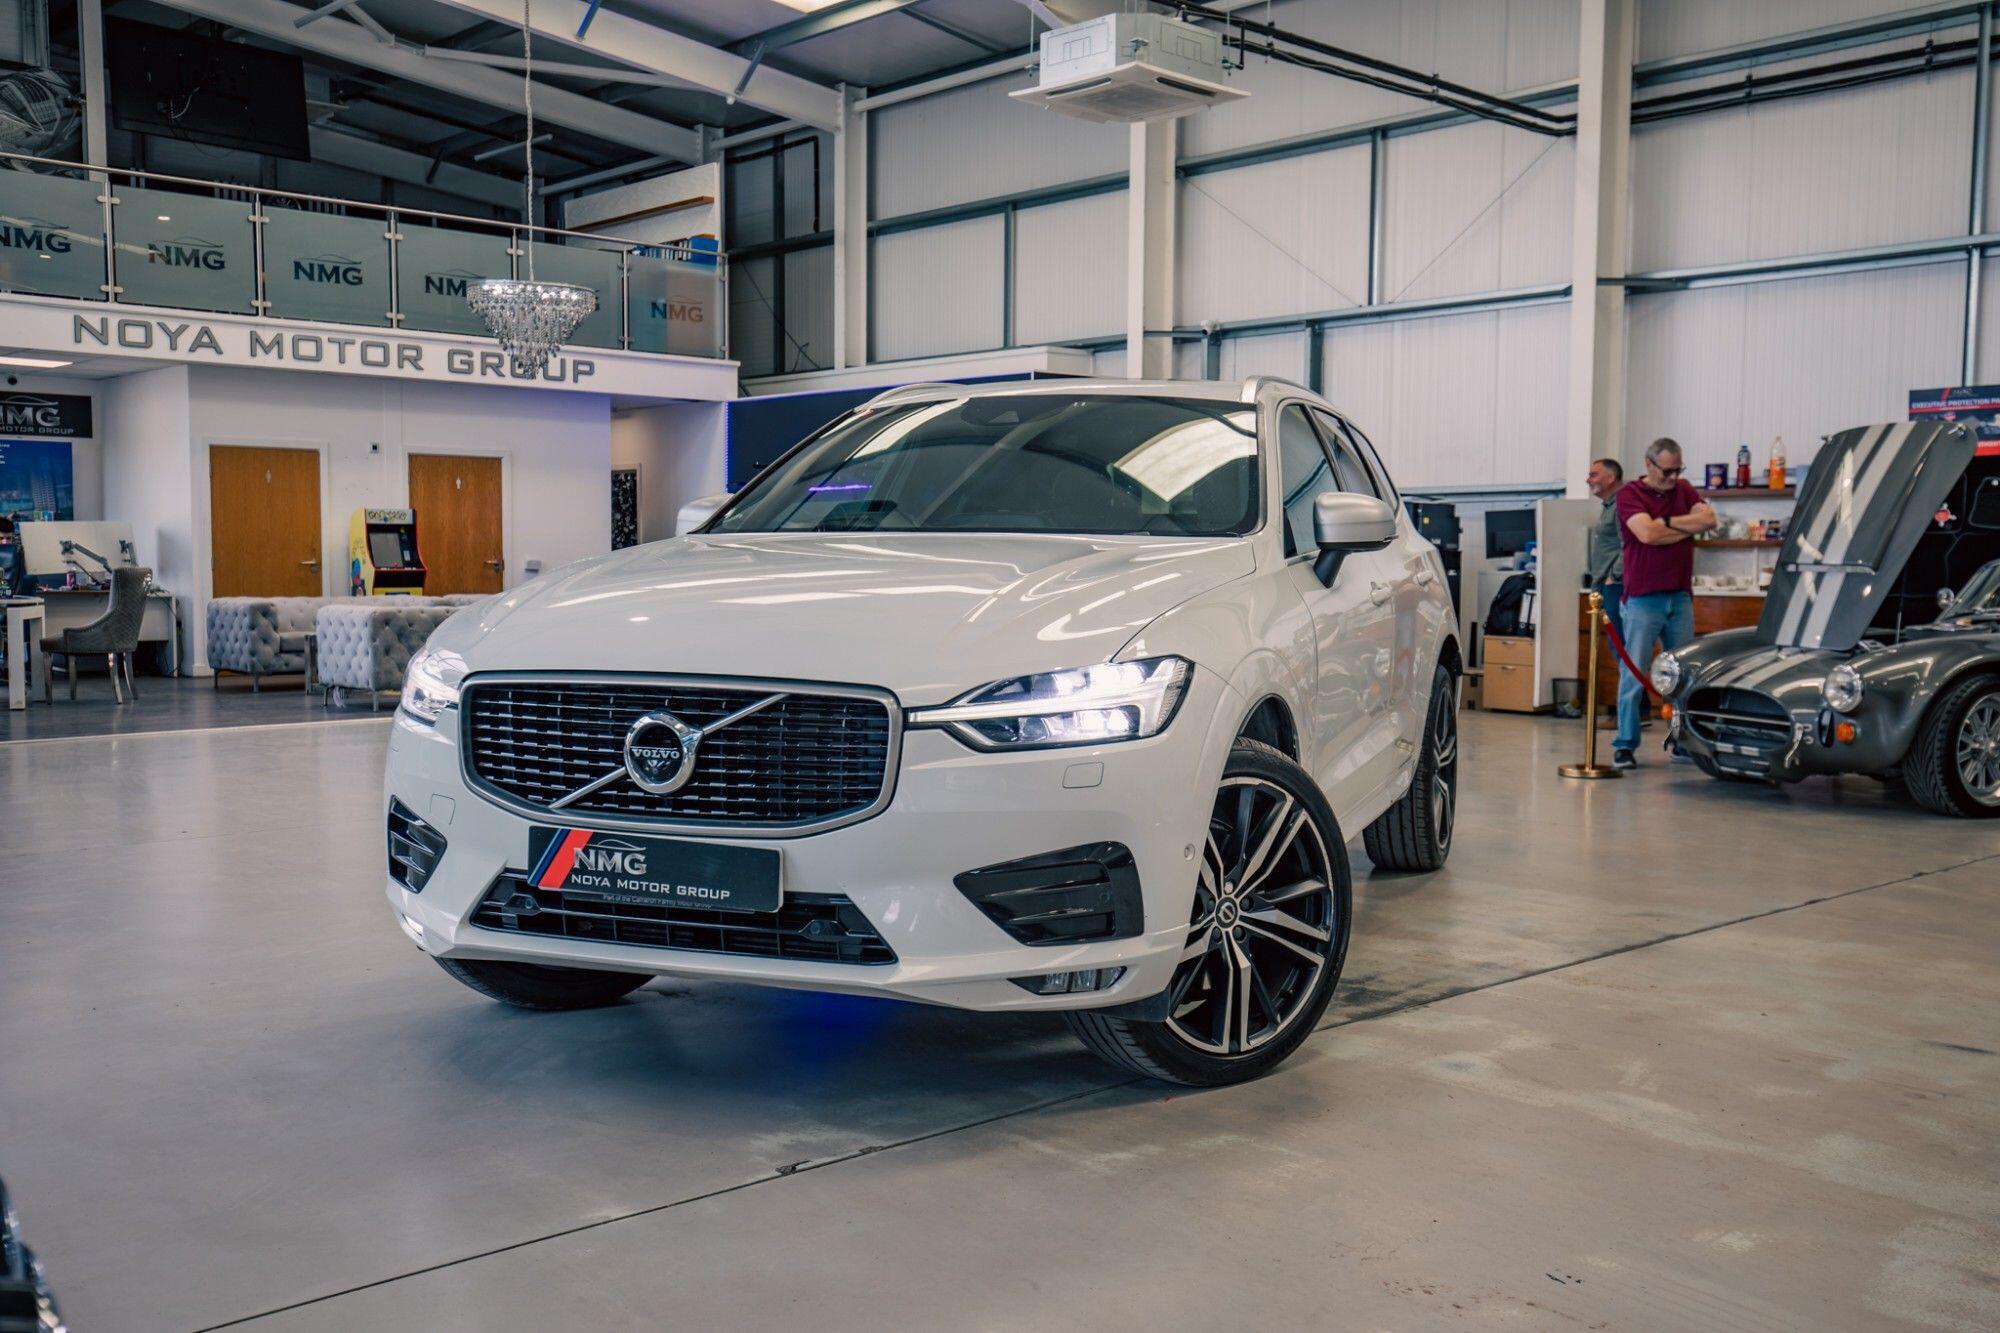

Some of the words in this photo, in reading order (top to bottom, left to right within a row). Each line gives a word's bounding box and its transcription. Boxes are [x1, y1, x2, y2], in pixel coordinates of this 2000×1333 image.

[148, 243, 226, 271] NMG
[293, 261, 364, 286] NMG
[425, 275, 467, 297] NM
[651, 301, 703, 323] NMG
[73, 314, 224, 356] NOYA
[250, 329, 424, 371] MOTOR
[0, 404, 60, 427] MG
[38, 426, 74, 434] GROUP
[631, 748, 680, 759] VOLVO
[573, 848, 647, 875] NMG
[571, 874, 611, 887] NOYA
[617, 878, 670, 894] MOTOR
[676, 885, 731, 900] GROUP
